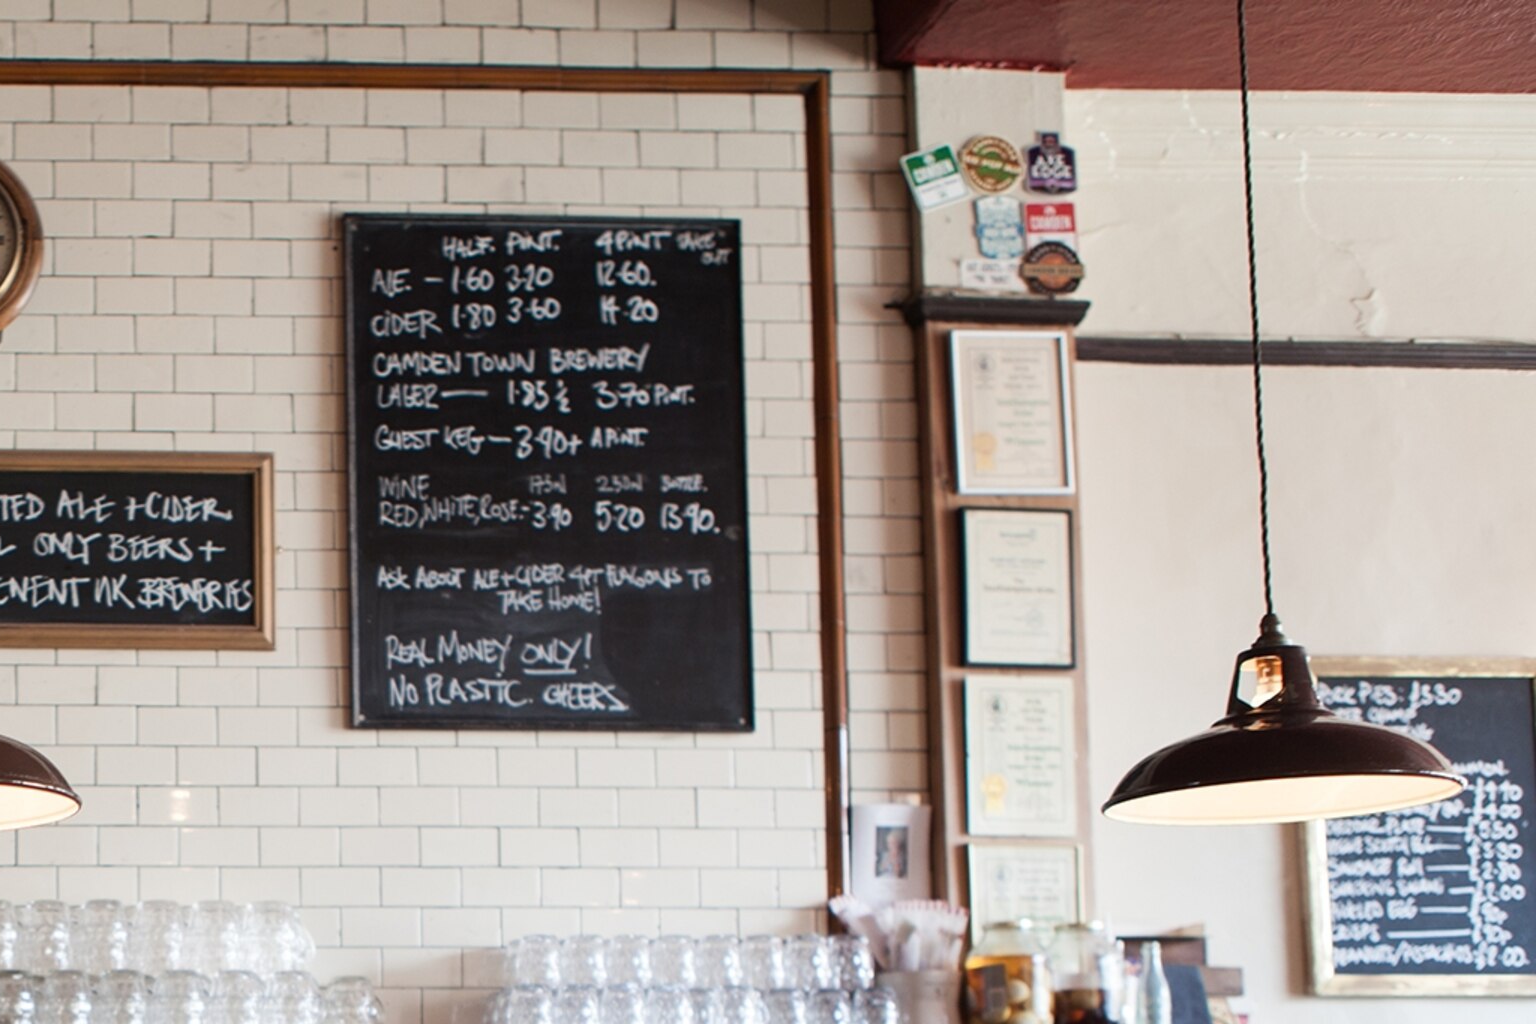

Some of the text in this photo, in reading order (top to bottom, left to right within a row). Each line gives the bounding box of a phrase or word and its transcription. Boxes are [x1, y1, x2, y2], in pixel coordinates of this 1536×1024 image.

[371, 310, 442, 339] CIDER
[372, 342, 650, 377] CAMDEN TOWN BREWERY
[377, 383, 440, 409] LAGER
[374, 424, 439, 451] GUEST
[378, 474, 431, 499] WINE
[56, 489, 116, 523] ALE
[33, 531, 102, 565] ONLY
[107, 533, 193, 562] BEERS
[377, 567, 411, 590] ASK
[415, 566, 466, 590] ABOUT
[605, 563, 683, 589] FLAGONS
[687, 569, 713, 589] TO
[497, 588, 543, 616] TAKE
[385, 634, 435, 669] REAL
[437, 630, 513, 674] MONEY
[388, 673, 418, 708] NO
[542, 681, 630, 712] CHEERS
